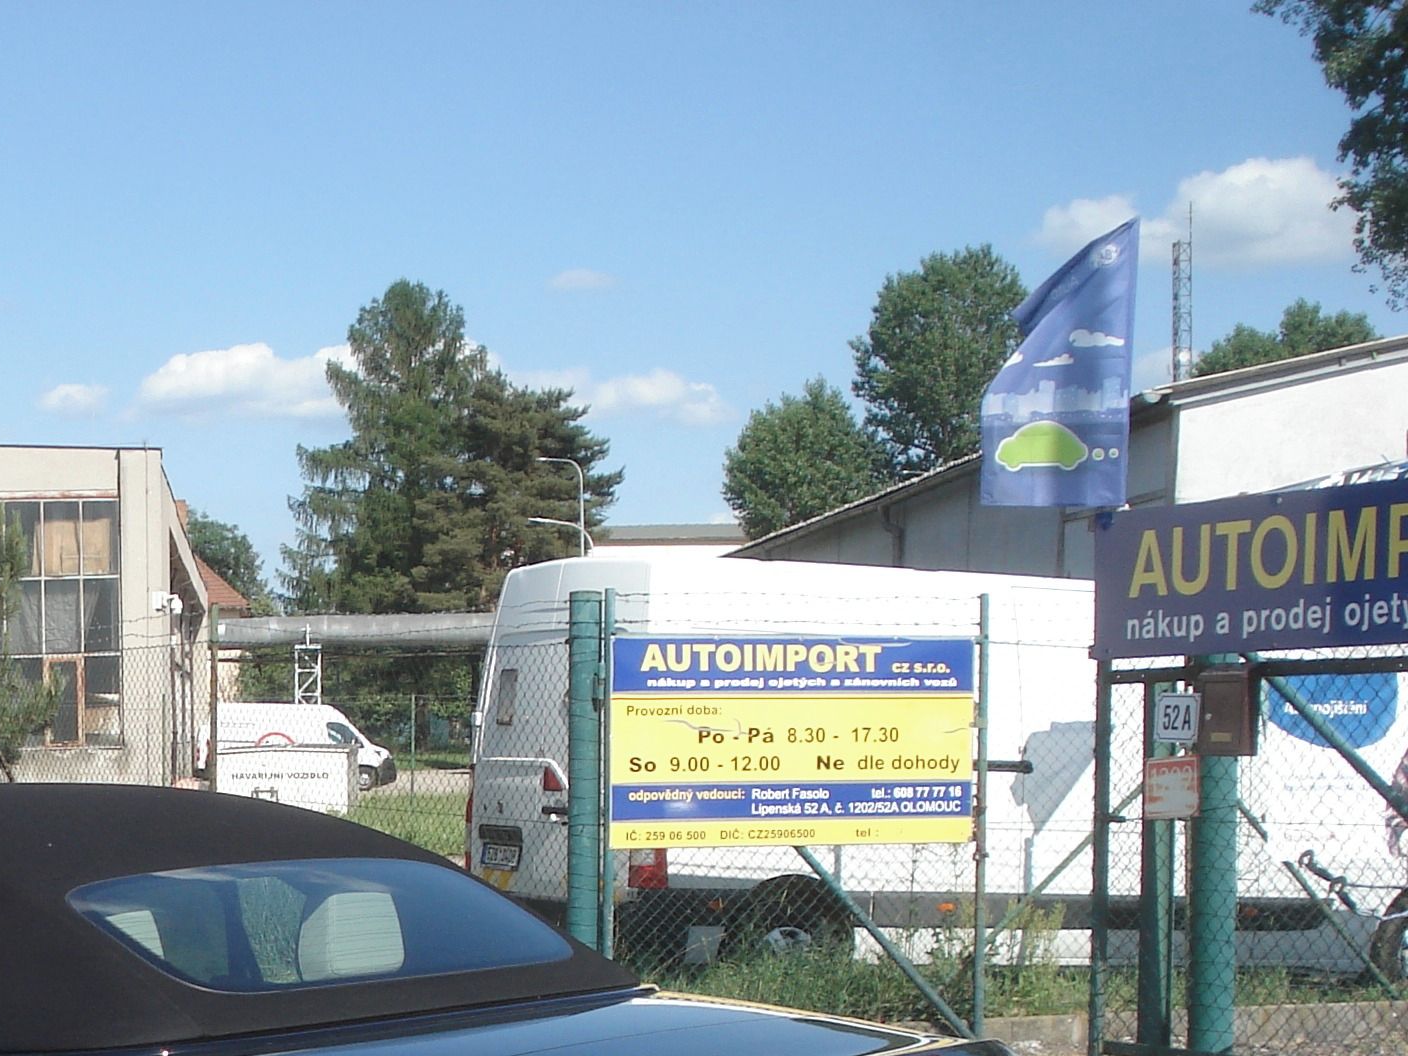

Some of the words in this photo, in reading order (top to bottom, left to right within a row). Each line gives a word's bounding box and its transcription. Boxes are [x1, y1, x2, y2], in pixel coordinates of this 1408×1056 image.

[1126, 609, 1205, 642] nákup
[1215, 611, 1230, 634] a
[1243, 597, 1332, 639] prodej
[640, 643, 882, 673] AUTOIMPORT
[913, 662, 951, 673] s.r.o.
[646, 676, 696, 689] nákup
[700, 678, 711, 687] a
[714, 676, 765, 689] prodej
[768, 676, 826, 689] ojetých
[830, 678, 840, 687] a
[844, 676, 920, 687] zánovních
[626, 704, 683, 716] Provozní
[686, 704, 722, 716] doba:
[698, 727, 725, 744] Po
[747, 727, 775, 744] Pá
[787, 727, 825, 743] 8.30
[851, 726, 899, 743] 17.30
[629, 756, 657, 773] So
[669, 756, 710, 772] 9.00
[730, 755, 781, 772] 12.00
[816, 755, 845, 770] Ne
[857, 754, 885, 770] dle
[891, 754, 960, 773] dohody
[751, 787, 790, 800] Robert
[915, 786, 930, 798] 77
[932, 785, 946, 798] 77
[751, 802, 802, 816] Lipenská
[900, 800, 961, 812] OLOMOUC
[669, 831, 683, 841] 06
[686, 831, 706, 841] 500
